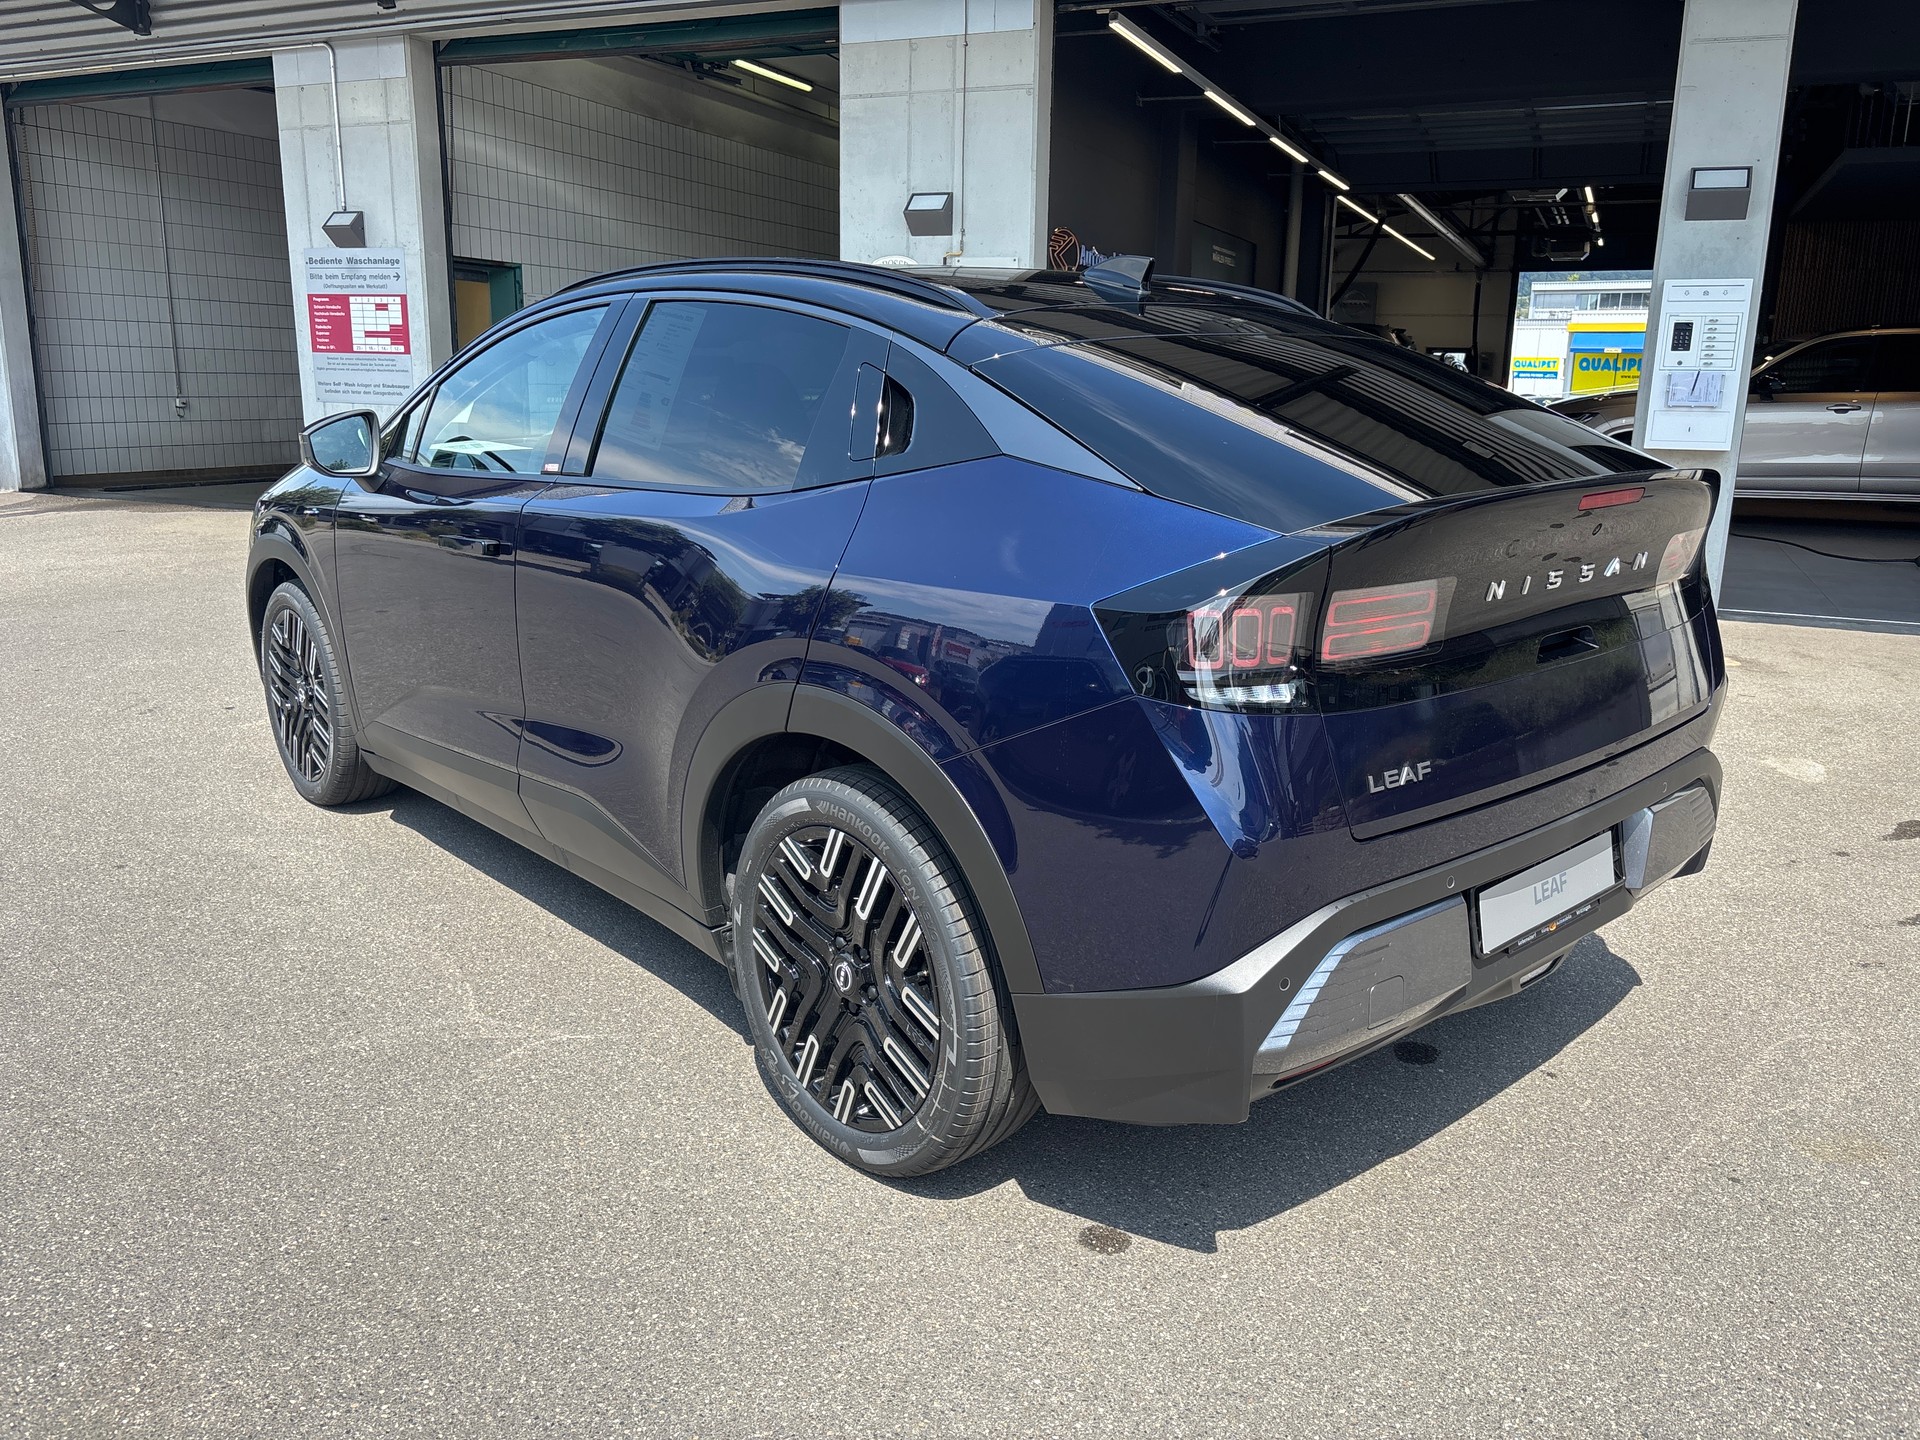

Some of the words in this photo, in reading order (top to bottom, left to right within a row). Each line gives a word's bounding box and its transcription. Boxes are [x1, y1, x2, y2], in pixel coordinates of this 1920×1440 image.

[308, 257, 343, 265] Bediente
[346, 257, 400, 266] Waschanlage
[341, 273, 367, 281] Empfang
[1514, 360, 1557, 368] QUALIPET
[1485, 551, 1648, 602] NISSAN
[1367, 760, 1432, 794] LEAF
[1533, 871, 1567, 906] LEAF
